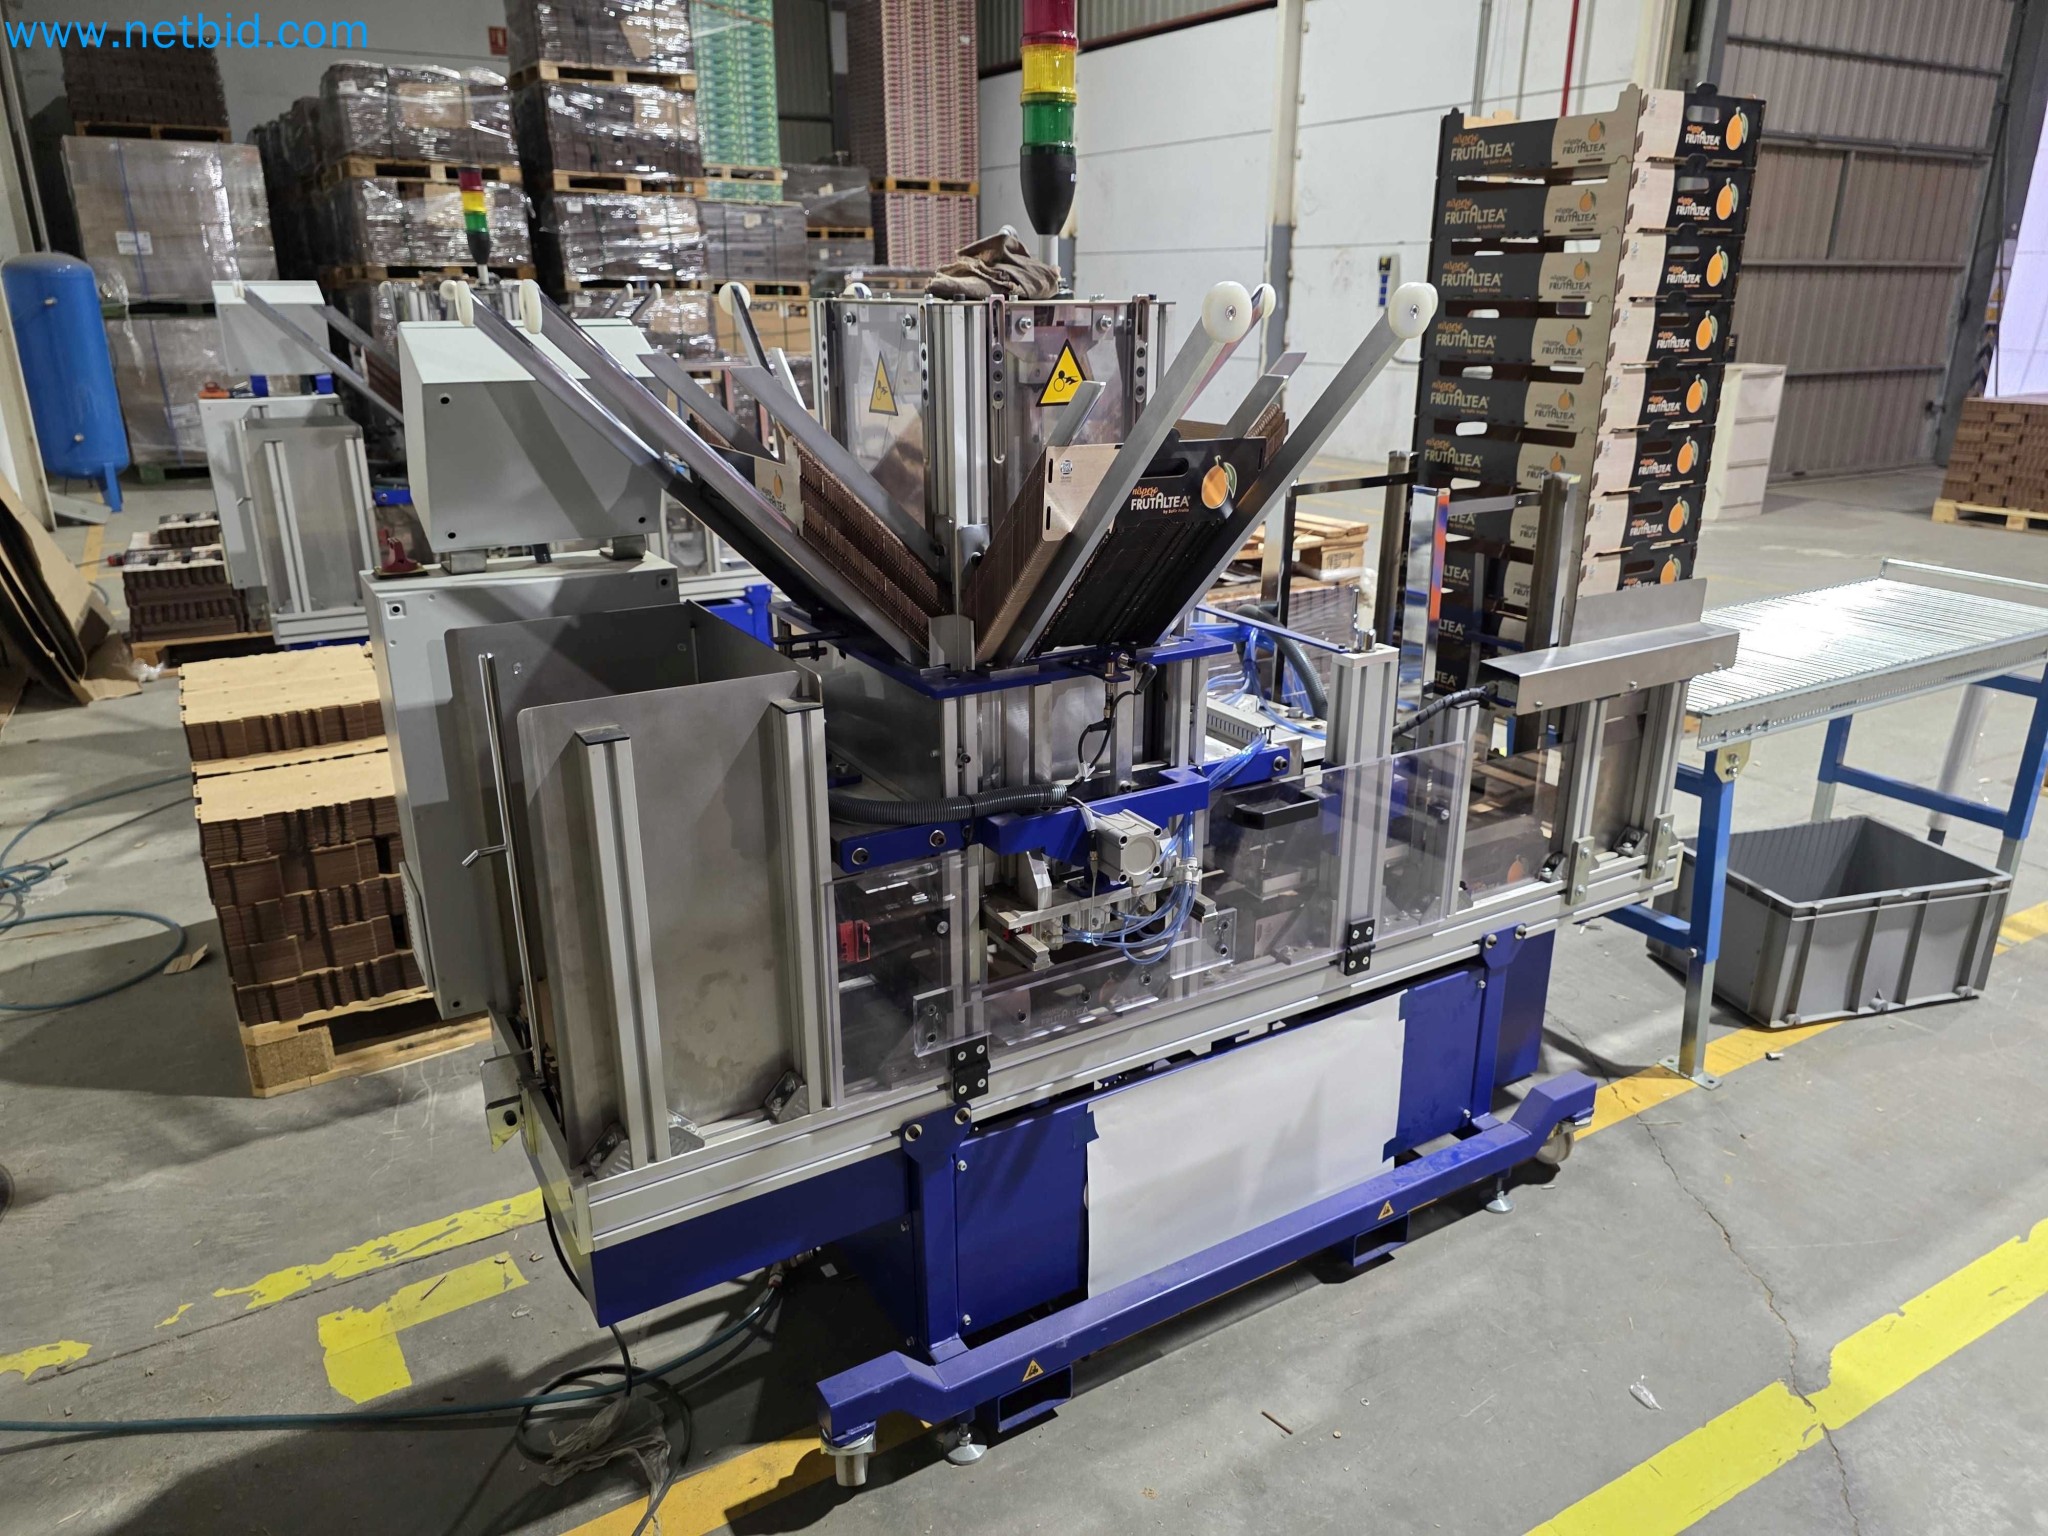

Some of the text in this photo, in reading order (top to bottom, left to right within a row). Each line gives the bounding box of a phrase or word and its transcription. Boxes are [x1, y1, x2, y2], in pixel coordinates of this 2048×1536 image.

[1450, 139, 1513, 162] FRUTALTEA
[1444, 205, 1506, 224] FRUTALTEA
[1441, 268, 1501, 287] FRUTALTEA
[1436, 329, 1495, 348] FRUTALTEA
[1430, 389, 1488, 409] FRUTALTEA
[1424, 447, 1482, 468] FRUTALTEA
[1131, 492, 1189, 511] FRUTALTEA
